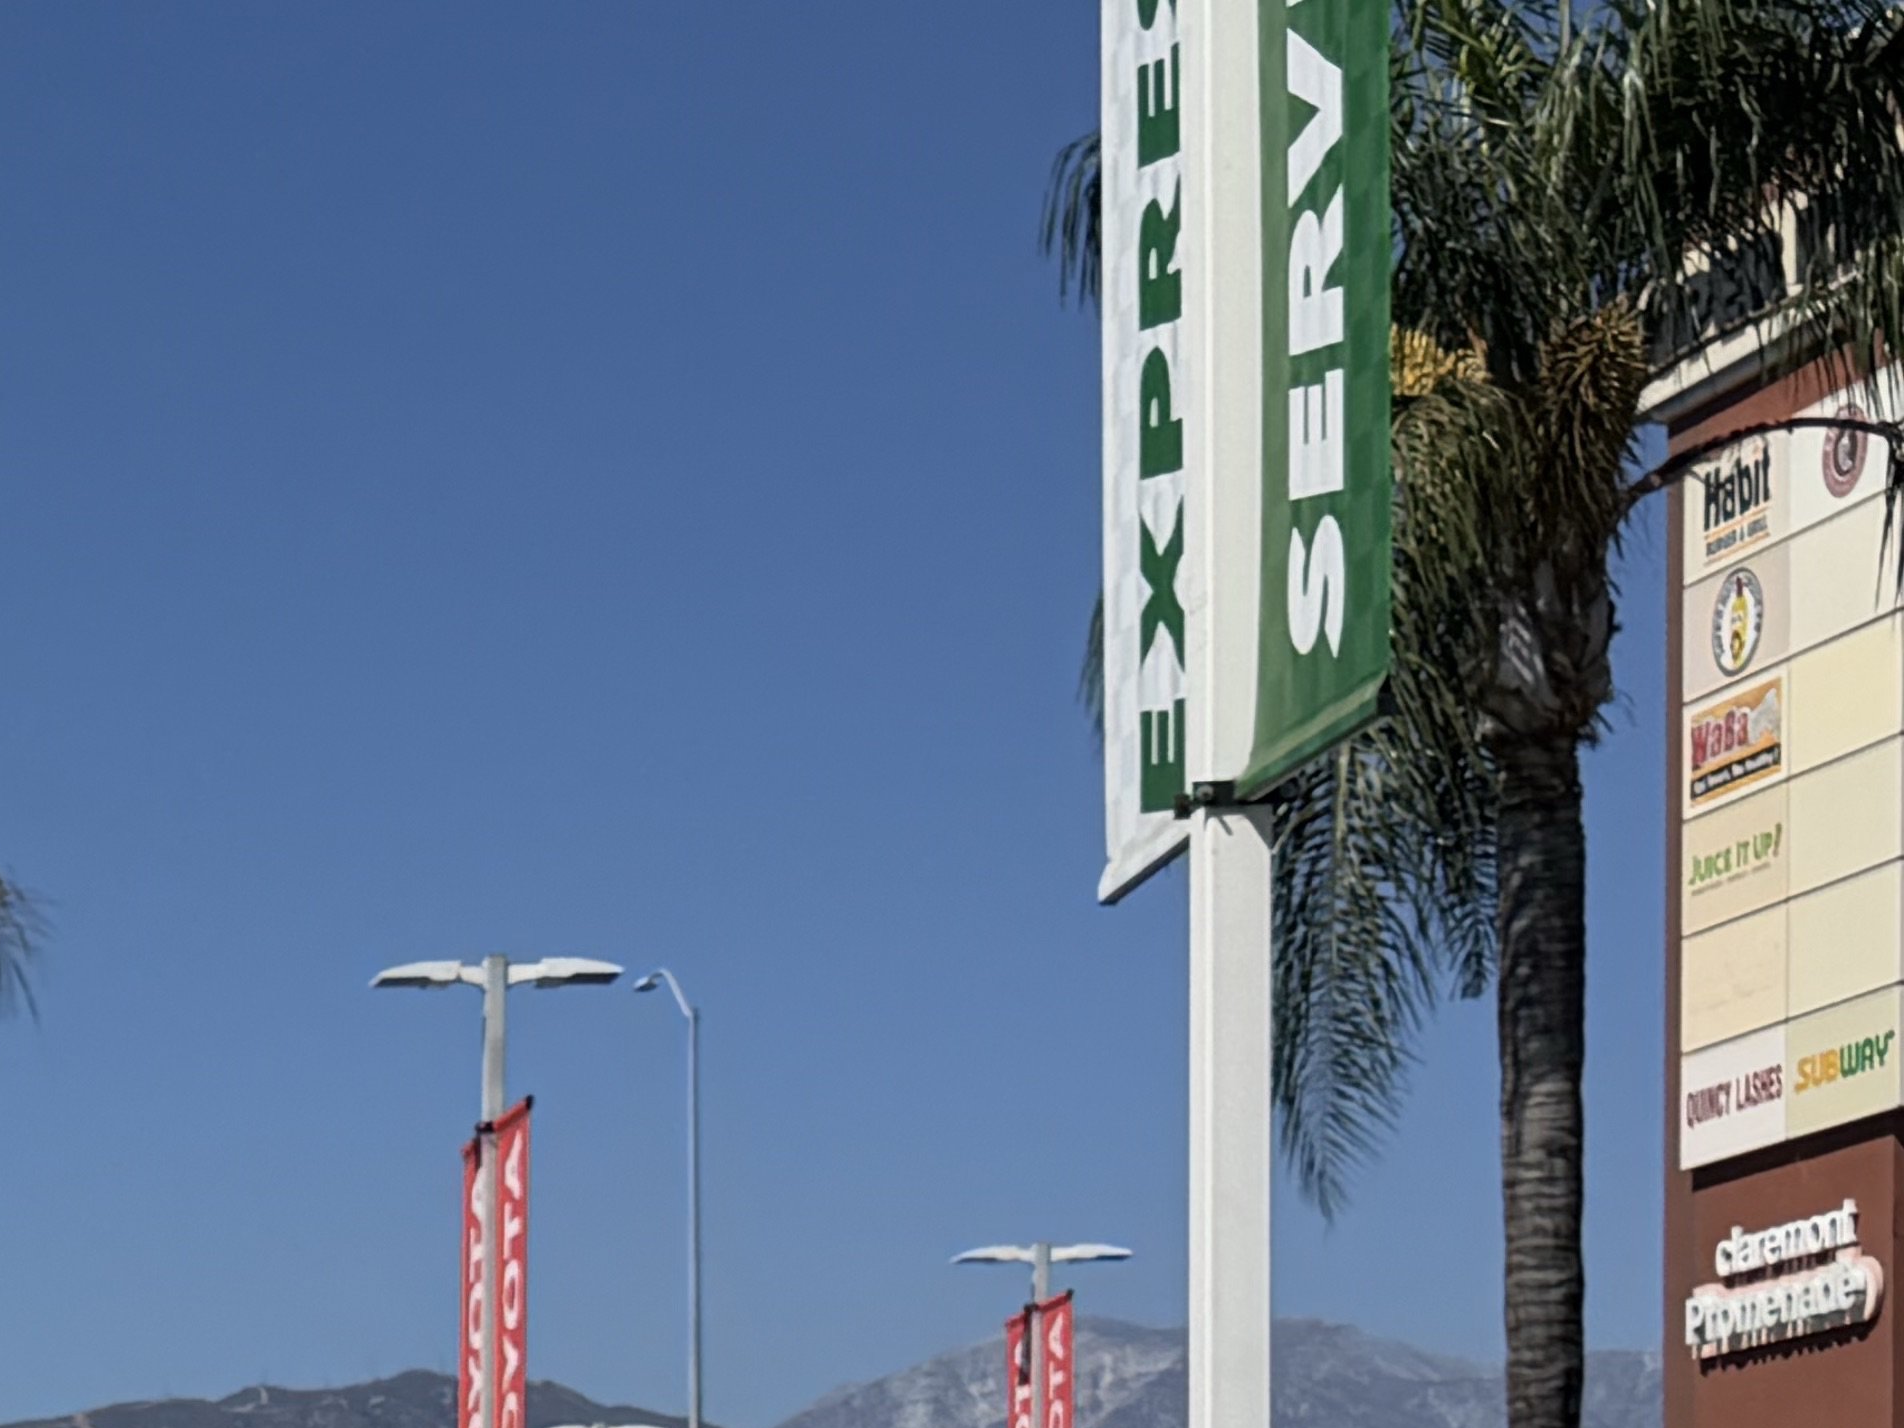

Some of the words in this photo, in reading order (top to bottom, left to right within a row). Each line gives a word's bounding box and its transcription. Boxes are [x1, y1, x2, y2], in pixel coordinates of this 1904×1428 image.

[1704, 444, 1770, 532] Habit
[1736, 841, 1750, 868] IT
[1687, 1080, 1732, 1129] QUINCY
[1736, 1062, 1784, 1112] LASHES
[1795, 1030, 1895, 1094] SUBWAY
[1715, 1198, 1860, 1277] claremont
[1685, 1258, 1867, 1346] Promenade
